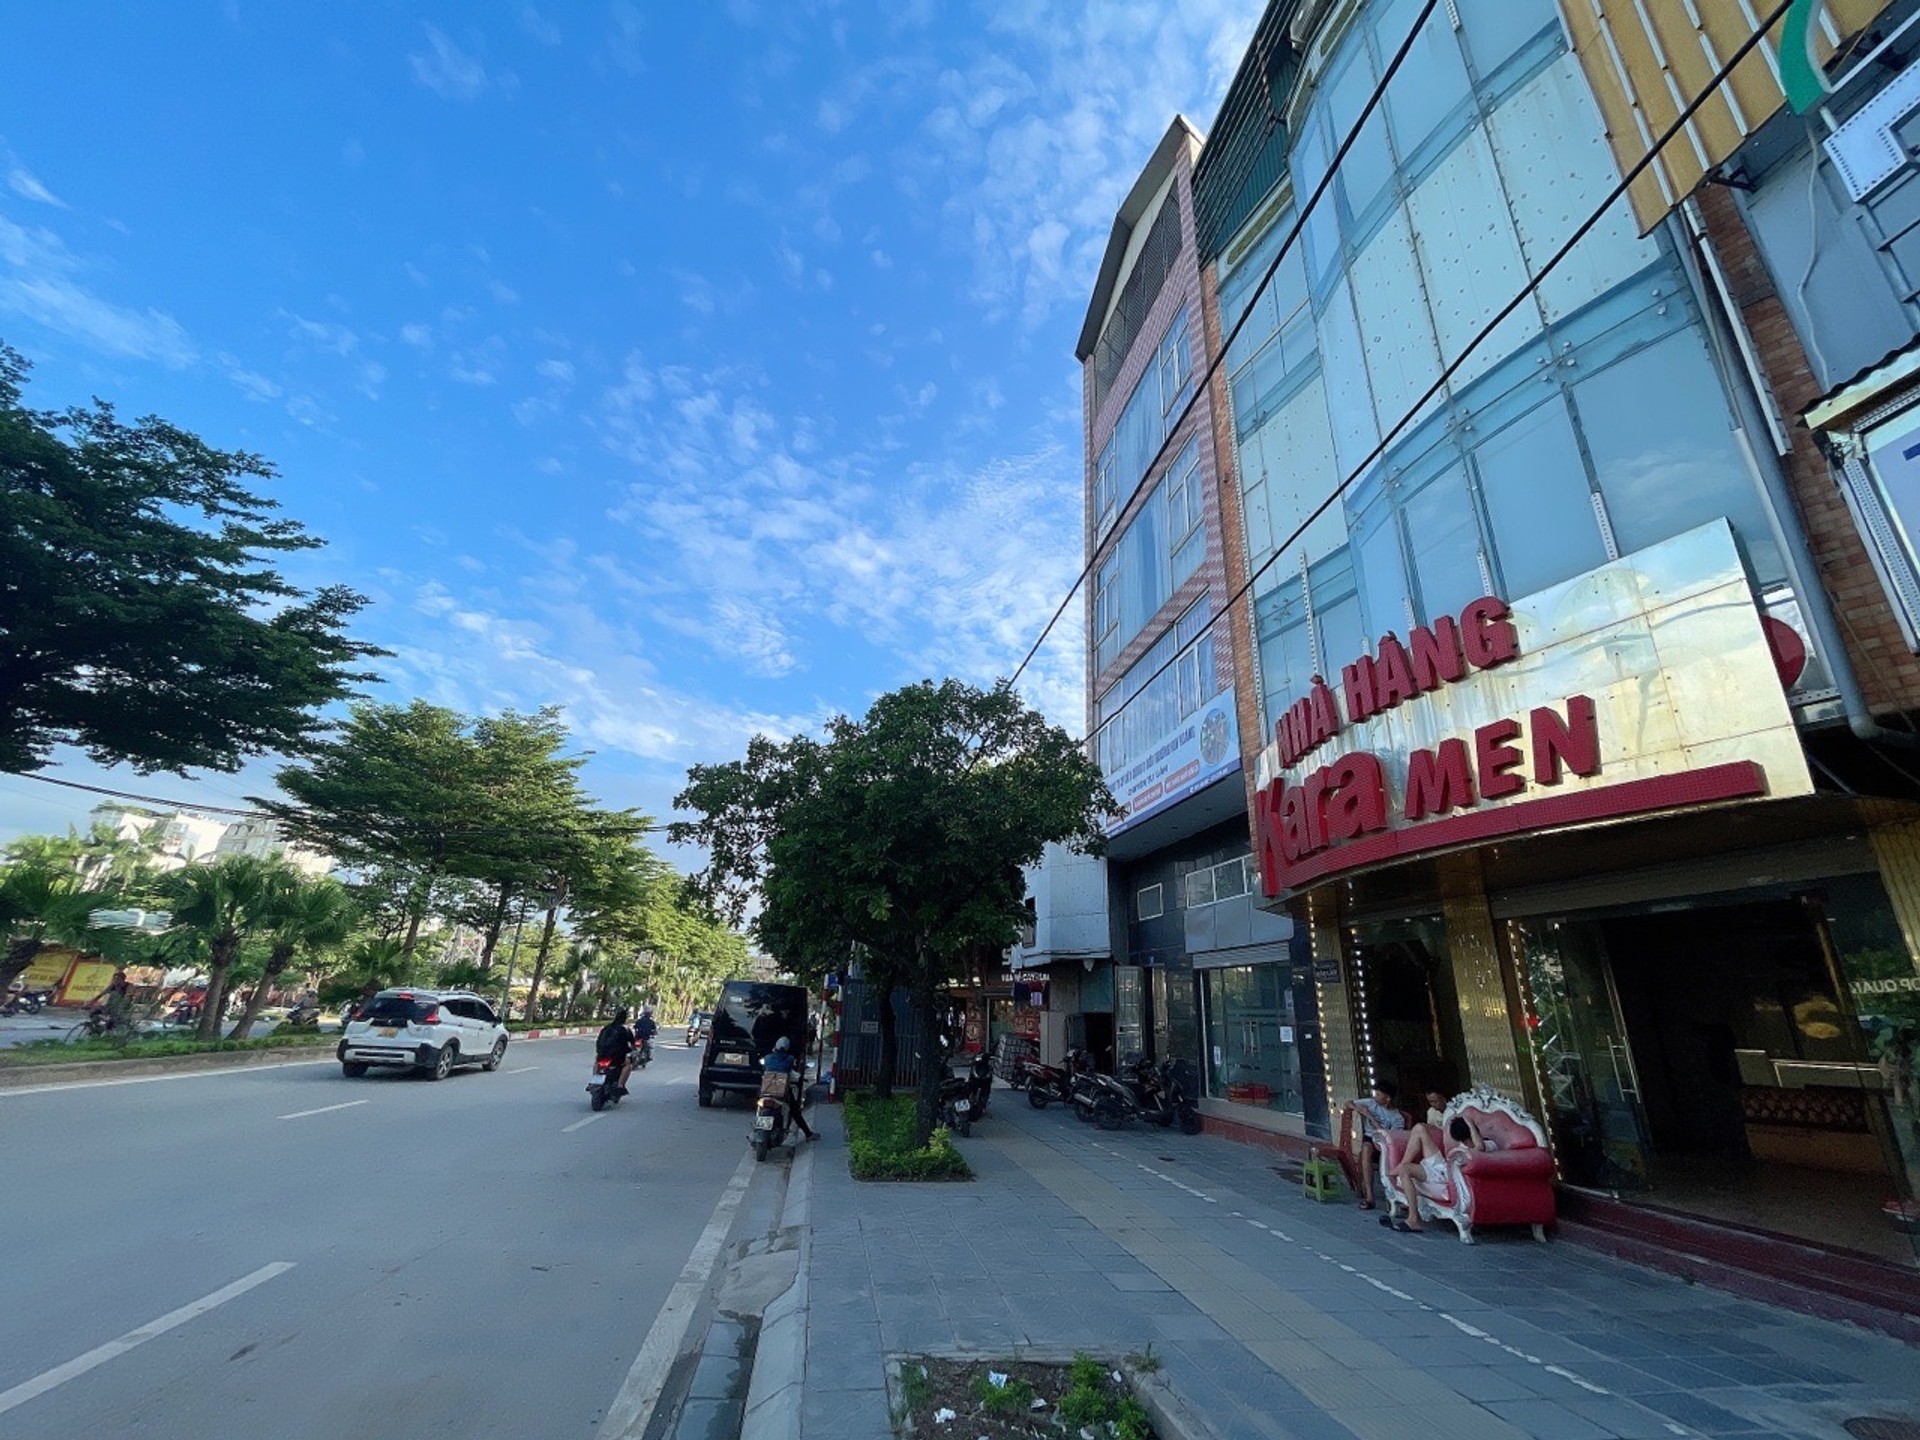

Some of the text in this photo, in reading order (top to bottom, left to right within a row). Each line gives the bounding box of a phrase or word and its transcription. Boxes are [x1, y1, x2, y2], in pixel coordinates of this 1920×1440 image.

[1275, 674, 1338, 769] NHÀ
[1341, 596, 1518, 723] HÀNG
[1255, 752, 1387, 897] Kara
[1404, 694, 1601, 820] MEN
